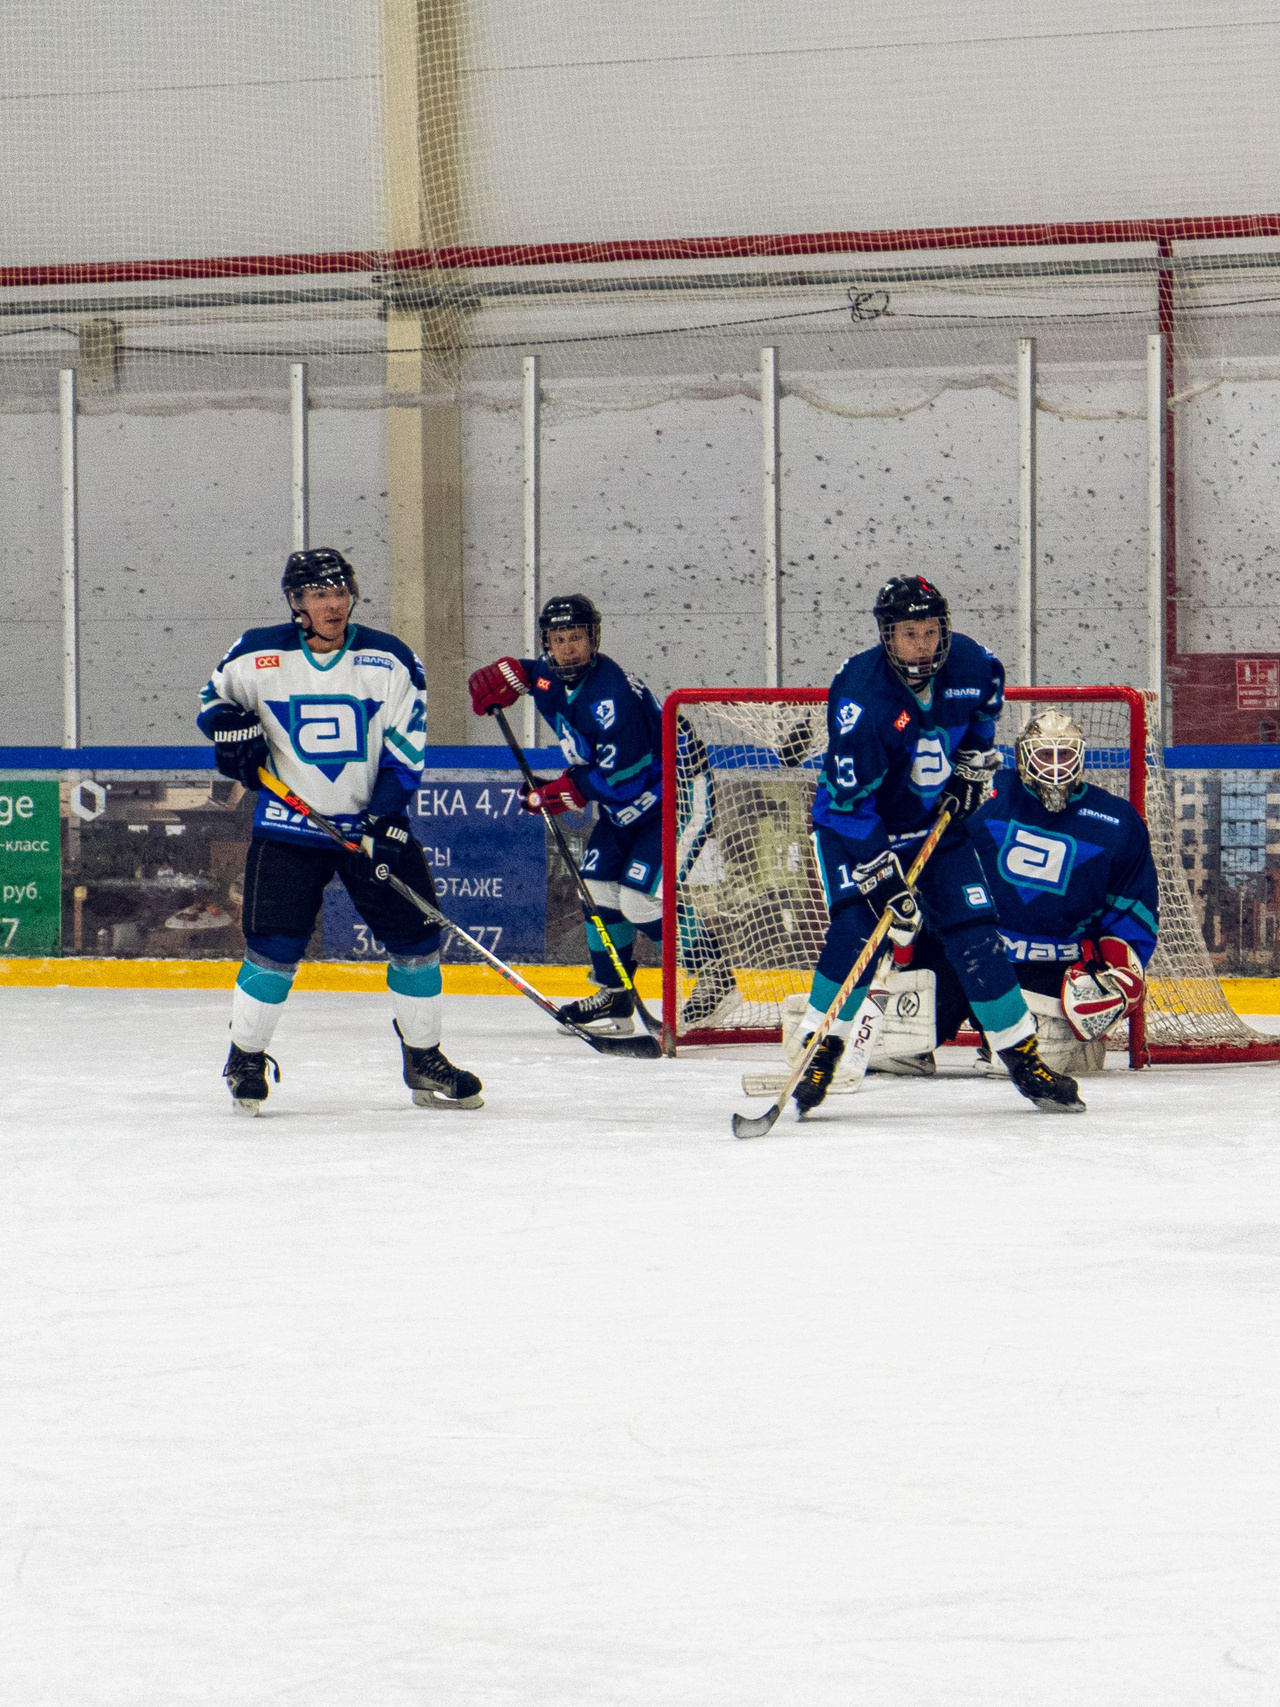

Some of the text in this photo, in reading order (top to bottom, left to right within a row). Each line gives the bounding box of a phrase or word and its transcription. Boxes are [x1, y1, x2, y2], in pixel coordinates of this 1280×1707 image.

[408, 789, 468, 816] ЕКА
[3, 882, 43, 902] руб.
[434, 878, 503, 898] ЭТАЖЕ
